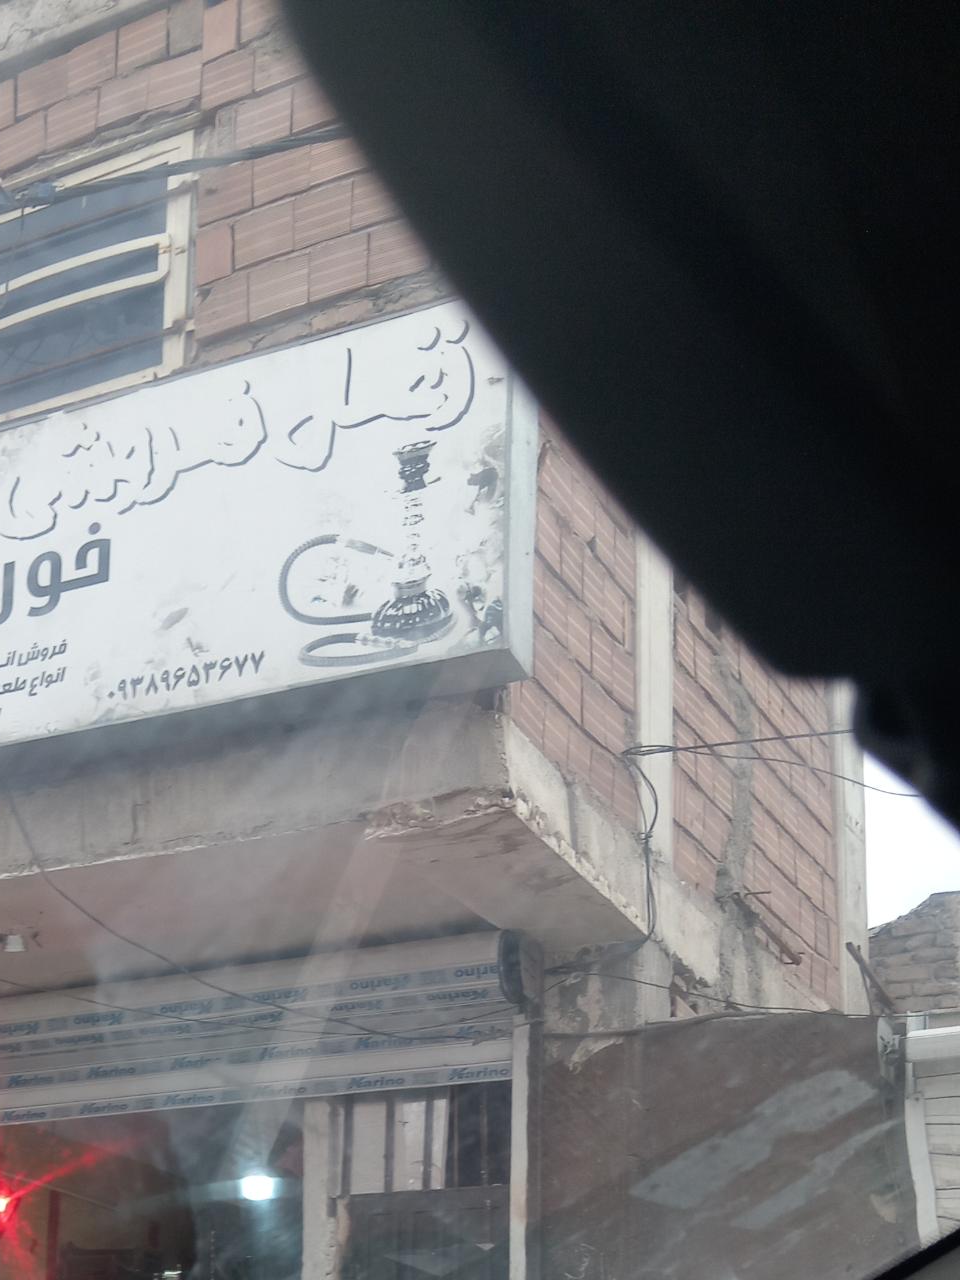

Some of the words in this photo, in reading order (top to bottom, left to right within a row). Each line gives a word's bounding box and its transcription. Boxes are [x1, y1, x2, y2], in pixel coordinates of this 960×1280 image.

[17, 639, 68, 667] فروش
[28, 666, 67, 697] انواع
[107, 650, 265, 700] ۰۹۳۸۹۶۵۳۶۷۷
